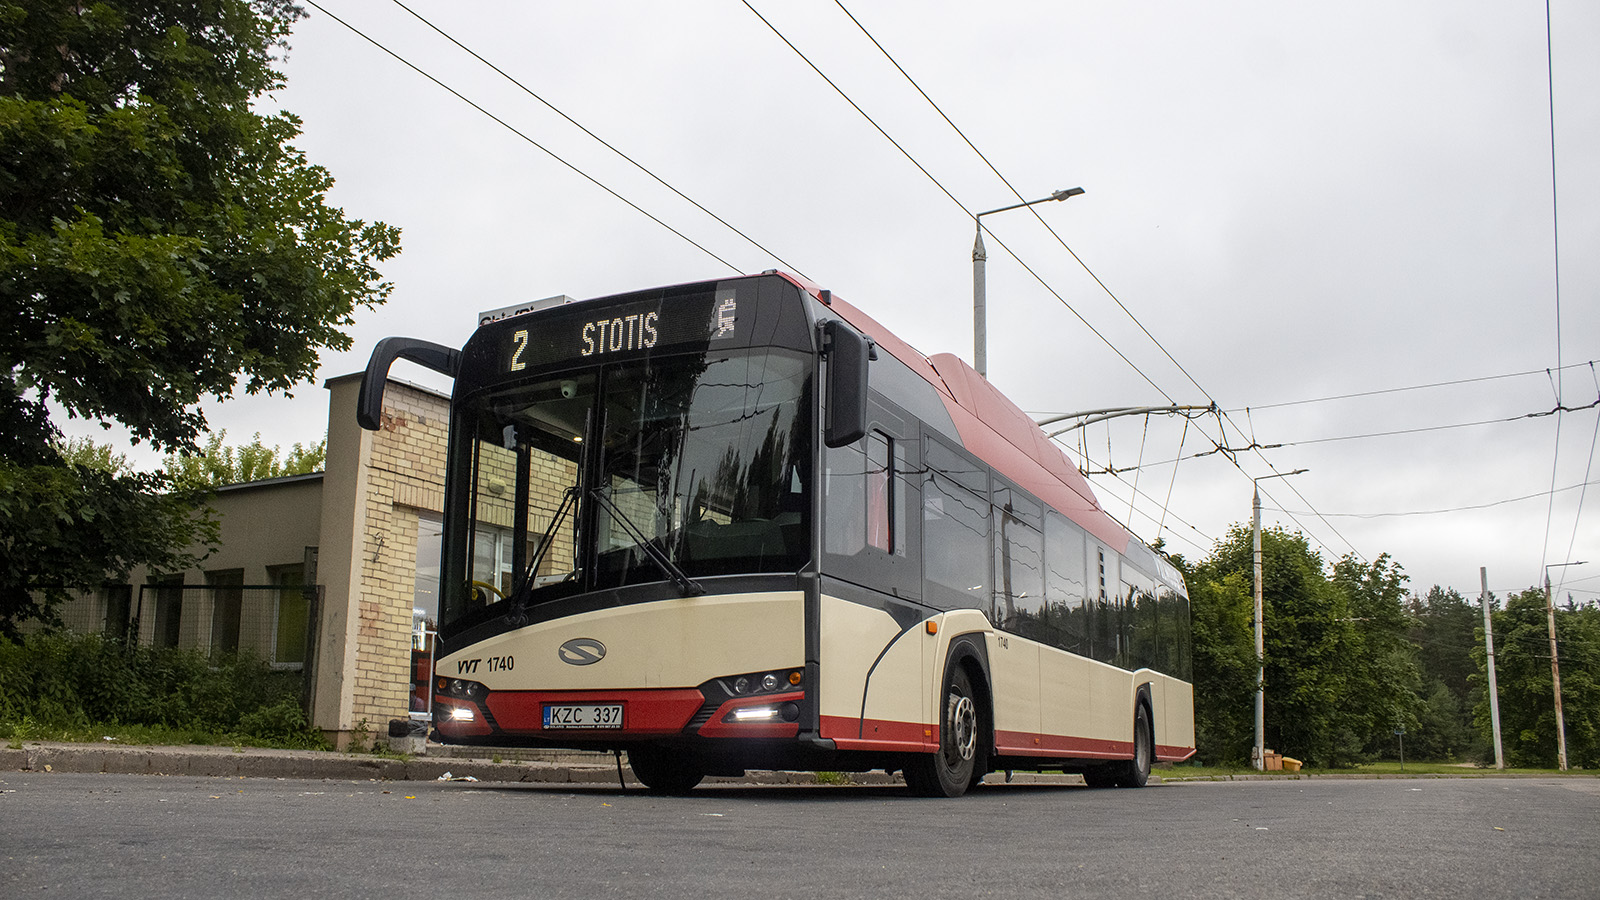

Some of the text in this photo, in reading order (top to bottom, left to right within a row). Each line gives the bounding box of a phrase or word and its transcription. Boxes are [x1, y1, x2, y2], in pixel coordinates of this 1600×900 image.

[511, 330, 528, 371] 2
[582, 312, 658, 356] STOTIS
[998, 636, 1008, 649] 1740
[458, 655, 514, 674] VVT 1740
[551, 706, 621, 724] KZC 337
